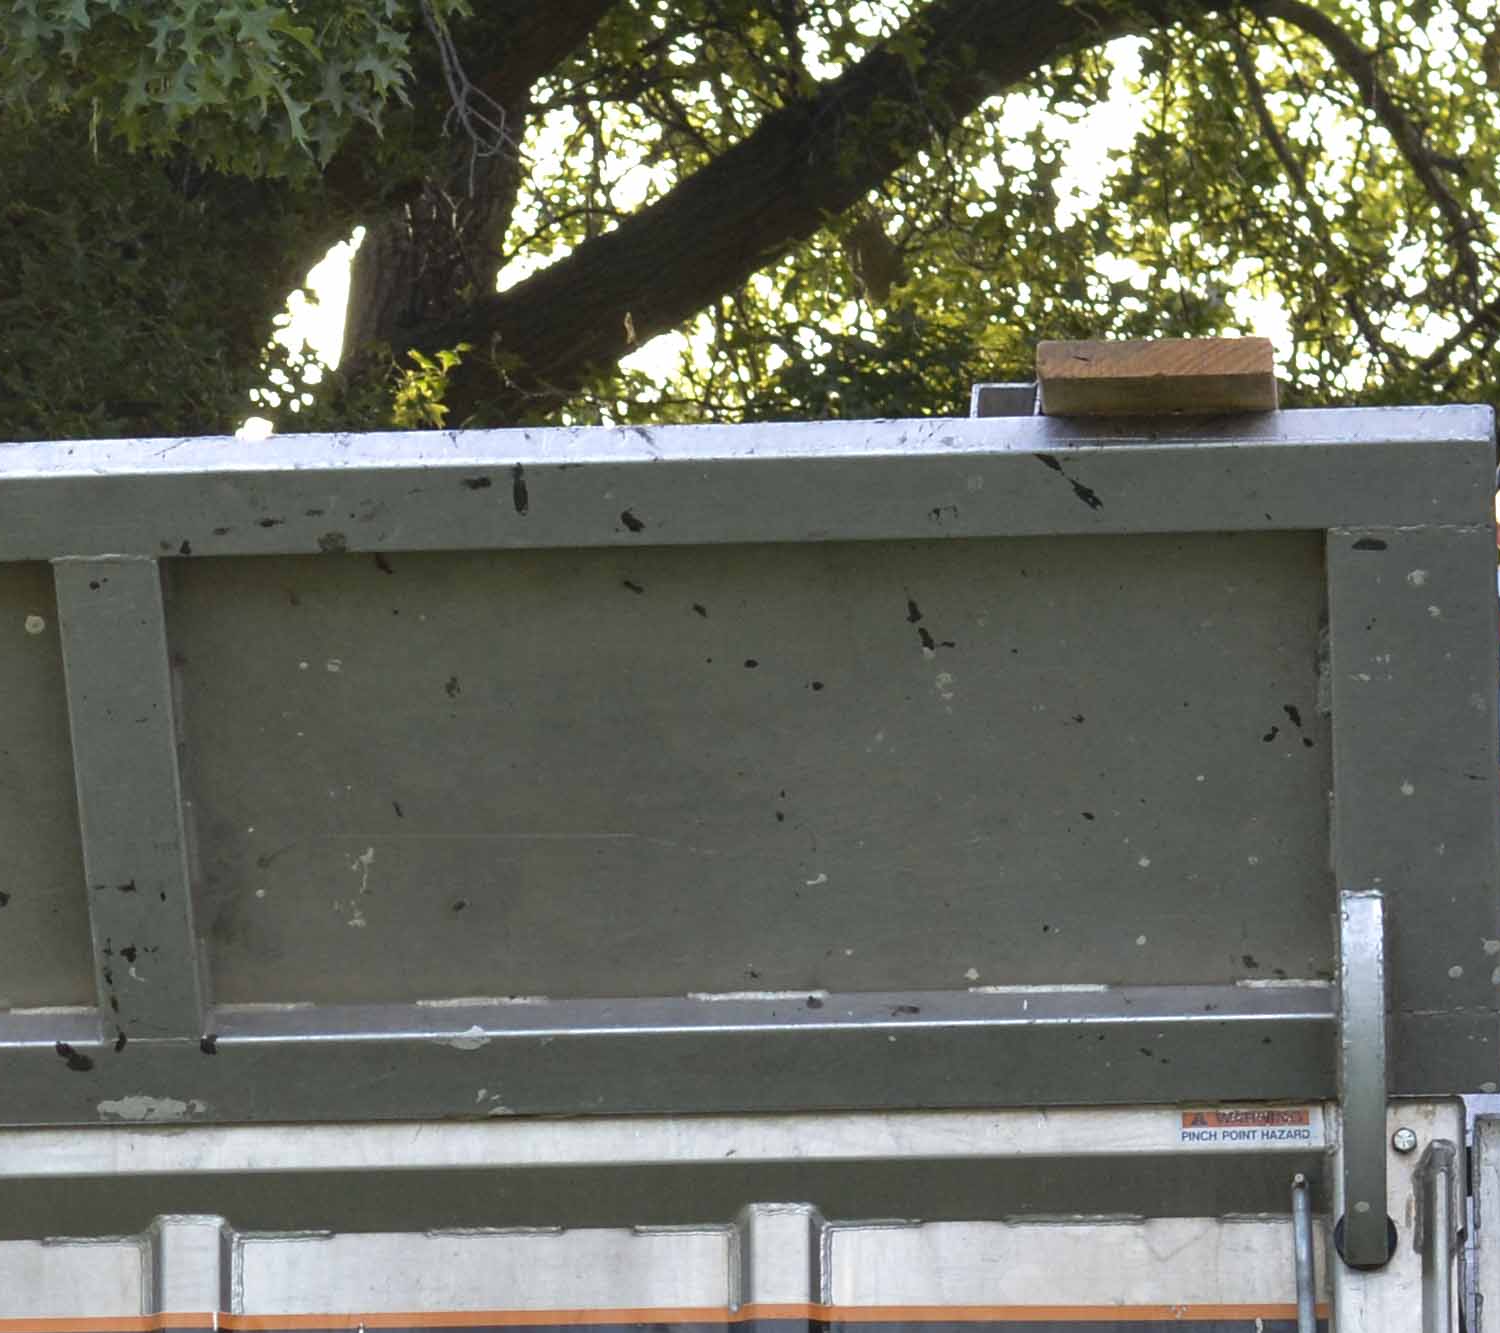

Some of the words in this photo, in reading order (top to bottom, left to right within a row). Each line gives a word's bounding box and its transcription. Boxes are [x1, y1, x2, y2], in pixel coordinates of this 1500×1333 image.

[1181, 1130, 1217, 1141] PINCH
[1222, 1129, 1257, 1140] POINT
[1261, 1129, 1310, 1140] HAZARD
